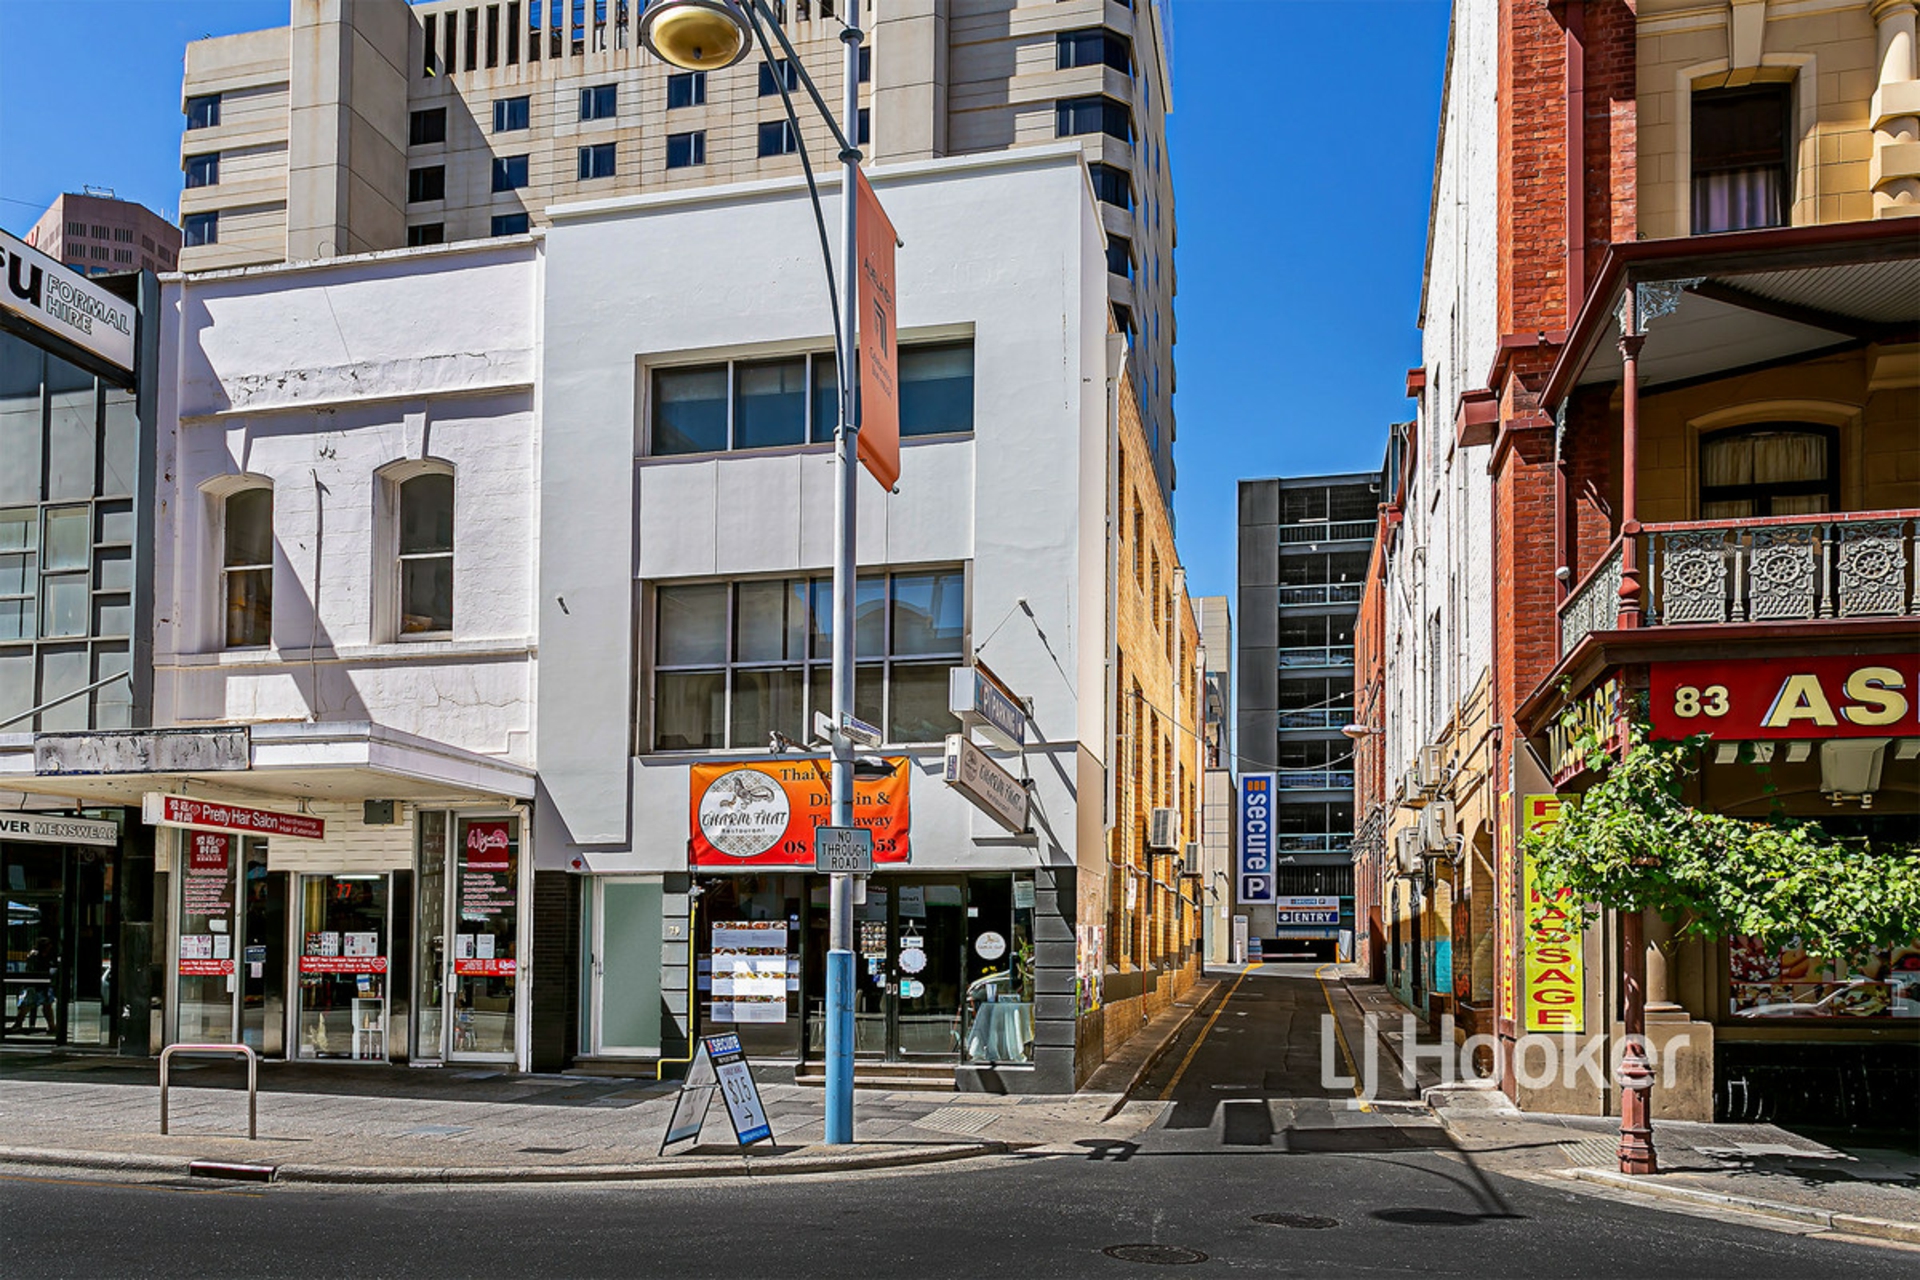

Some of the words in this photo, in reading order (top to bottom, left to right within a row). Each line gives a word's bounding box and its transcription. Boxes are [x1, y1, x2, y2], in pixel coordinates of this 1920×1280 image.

[47, 273, 130, 336] FORMAL
[46, 294, 92, 336] HIRE
[1674, 685, 1730, 718] 83
[1760, 666, 1920, 728] AS
[779, 768, 815, 781] Thai
[809, 792, 872, 806] Diin
[876, 792, 891, 805] &
[202, 804, 231, 827] Pretty
[231, 809, 251, 825] Hair
[252, 811, 278, 829] Salon
[808, 814, 893, 829] Taaway
[34, 821, 118, 841] MENSWEAR
[837, 831, 852, 843] NO
[1247, 793, 1267, 870] secure
[784, 839, 806, 854] 08
[822, 843, 868, 857] THROUGH
[831, 857, 859, 869] ROAD
[336, 883, 352, 899] 77
[1247, 878, 1265, 898] P
[1294, 913, 1332, 922] ENTRY
[668, 925, 681, 937] 79
[726, 1075, 752, 1109] $15
